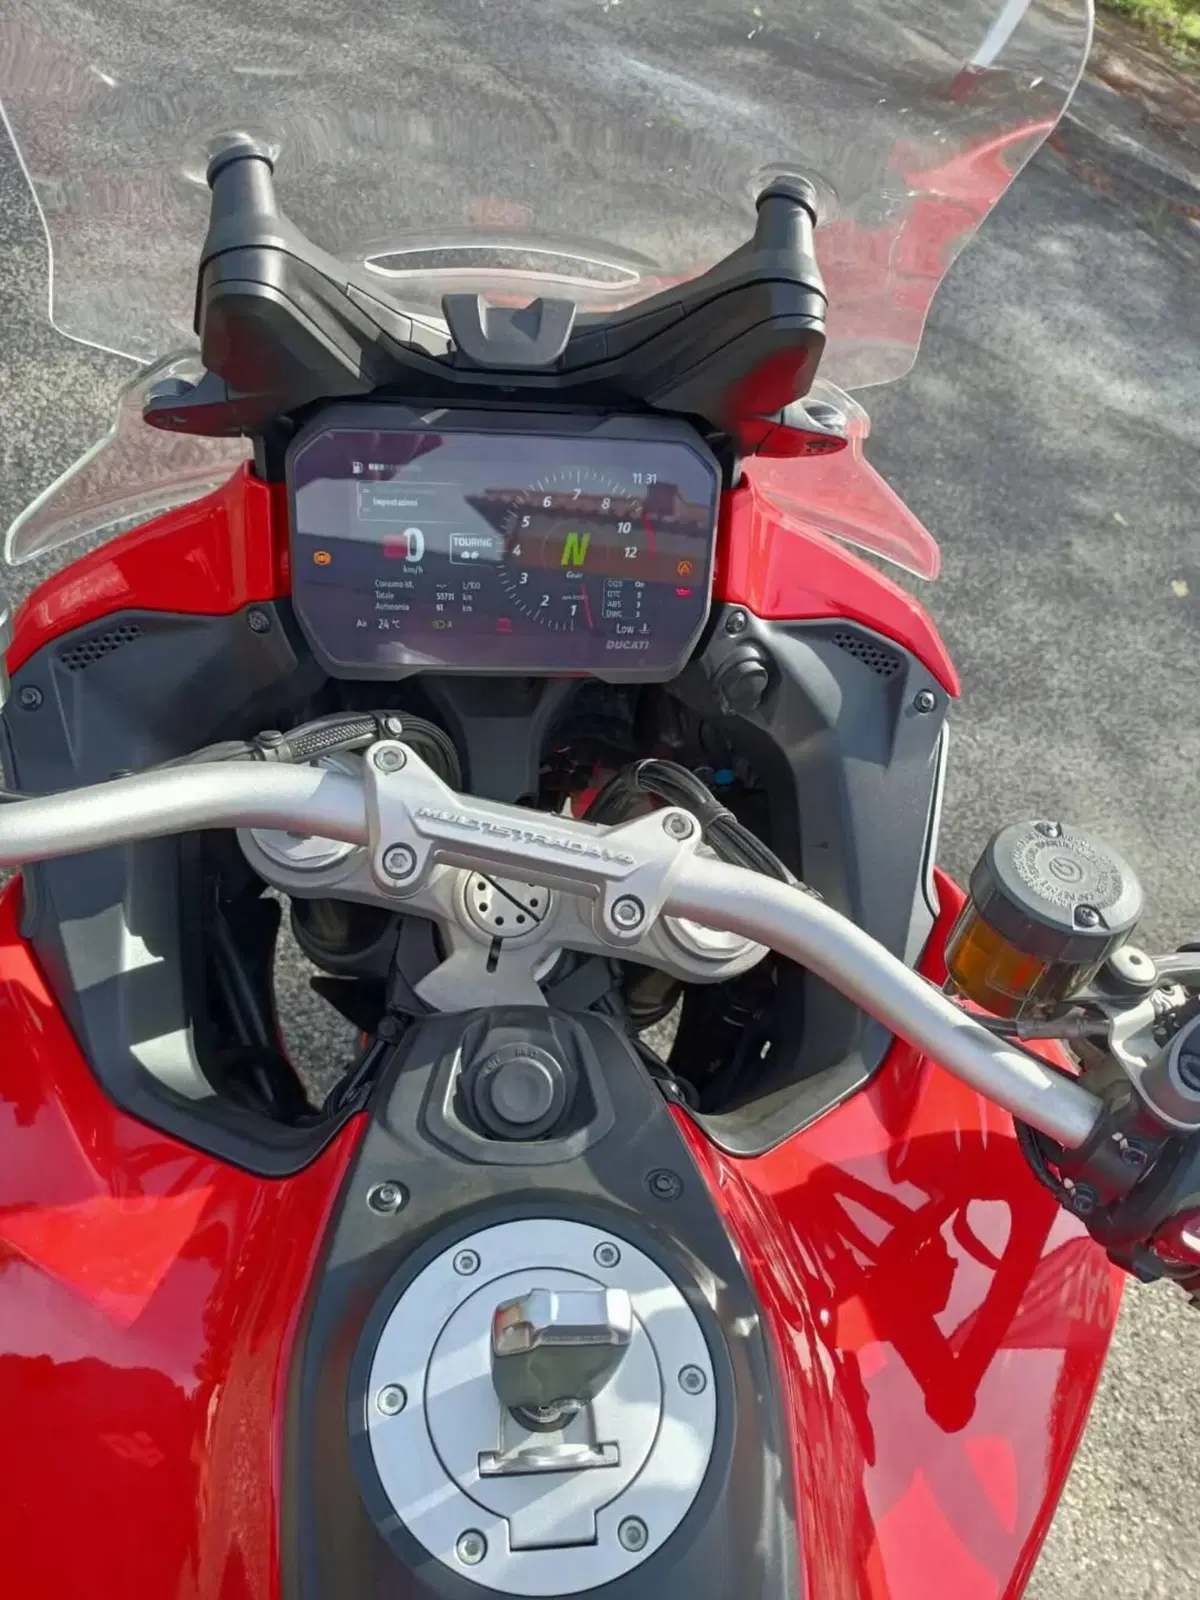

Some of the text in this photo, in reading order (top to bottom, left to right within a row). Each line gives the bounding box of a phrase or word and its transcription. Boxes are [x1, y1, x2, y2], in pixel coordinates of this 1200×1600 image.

[573, 488, 582, 501] 7
[543, 496, 552, 508] 6
[601, 498, 611, 510] 8
[521, 516, 530, 528] 5
[617, 522, 632, 534] 10
[453, 536, 493, 549] TOURING
[512, 544, 521, 556] 4
[561, 532, 591, 566] N
[624, 547, 638, 559] 12
[403, 565, 423, 576] km/h
[519, 572, 528, 585] 3
[540, 594, 549, 607] 2
[570, 604, 577, 616] 1
[616, 623, 634, 634] Low
[606, 639, 650, 650] DUCATI
